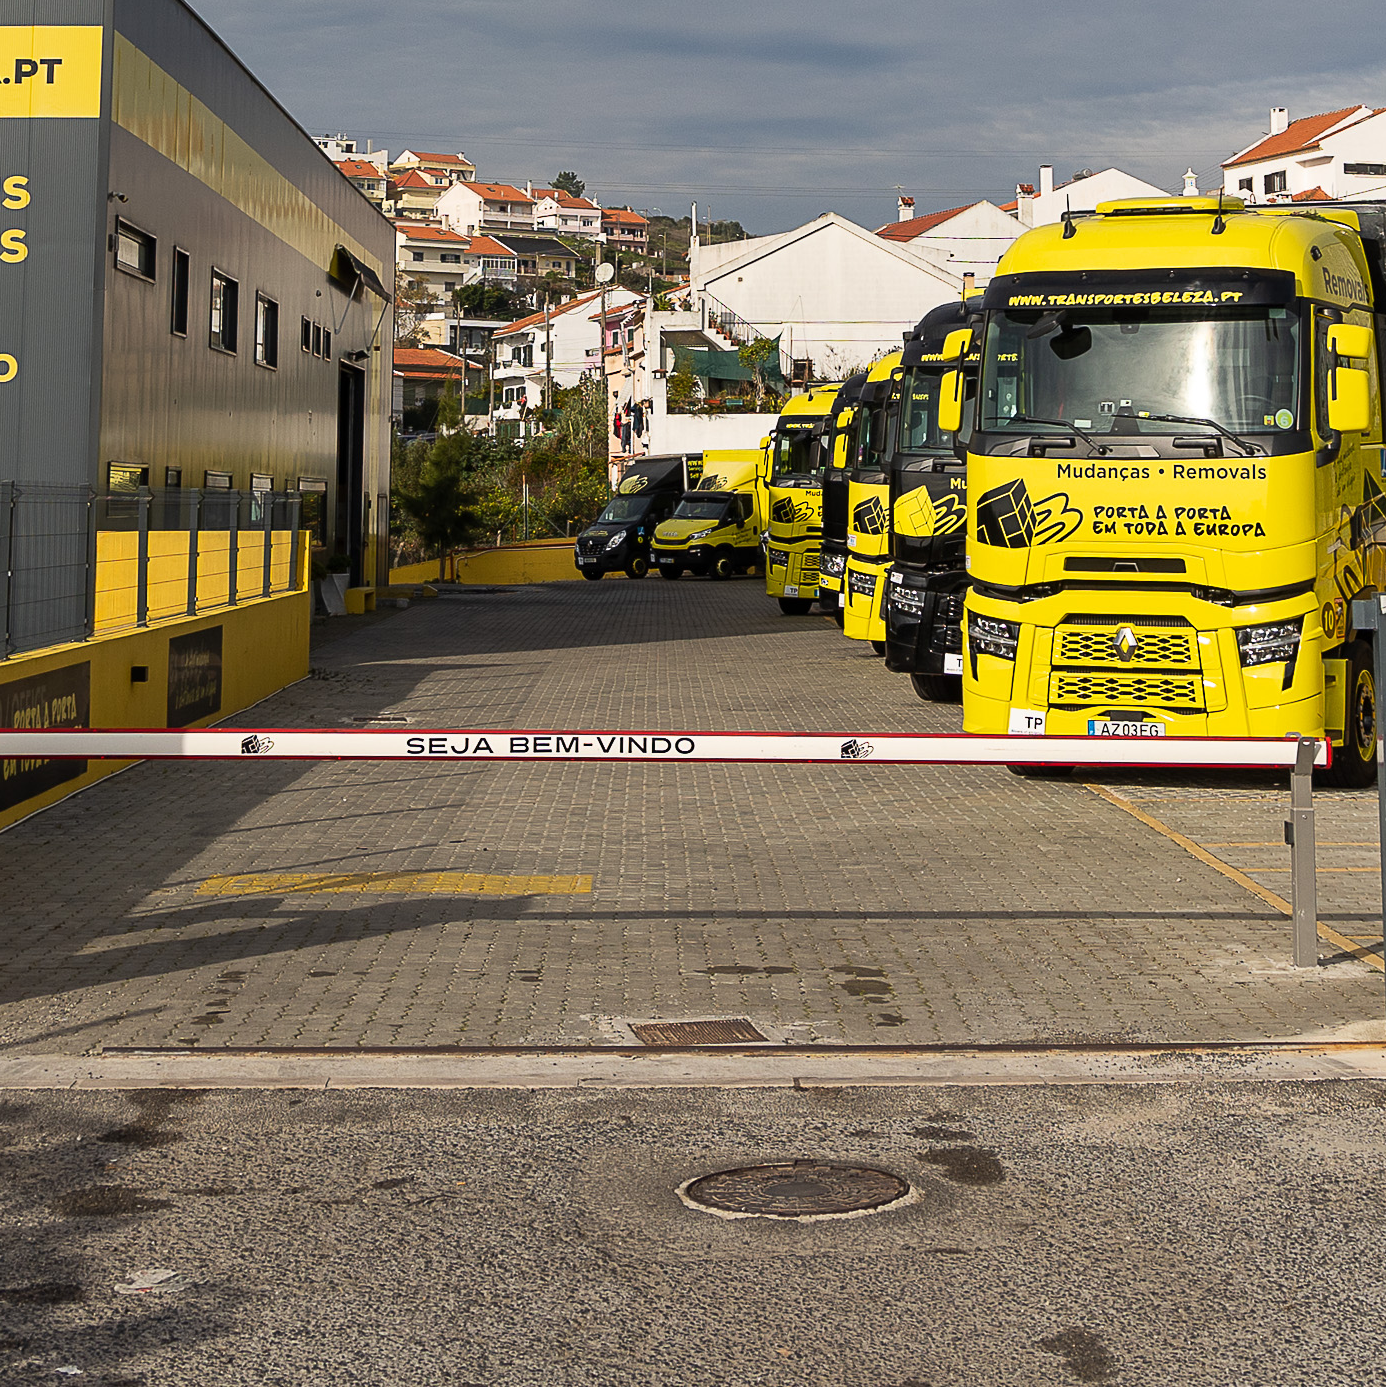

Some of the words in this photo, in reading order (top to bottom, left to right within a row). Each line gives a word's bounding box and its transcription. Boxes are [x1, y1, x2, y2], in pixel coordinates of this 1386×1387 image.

[1322, 266, 1370, 304] Removals
[1008, 290, 1244, 307] WWW.TRANSPORTESBELEZA.PT
[1056, 463, 1151, 482] Mudanças
[1173, 463, 1267, 480] Removals
[1093, 505, 1148, 520] PORTA
[1156, 505, 1168, 520] A
[1174, 505, 1232, 521] PORTA
[1093, 521, 1117, 535] EM
[1123, 522, 1169, 536] TODA
[1175, 522, 1187, 536] A
[1194, 522, 1266, 537] EUROPA
[1324, 609, 1334, 632] 10
[52, 692, 77, 725] PORTA
[1024, 716, 1043, 730] TP
[406, 736, 494, 755] SEJA
[509, 736, 695, 755] BEM-VINDO
